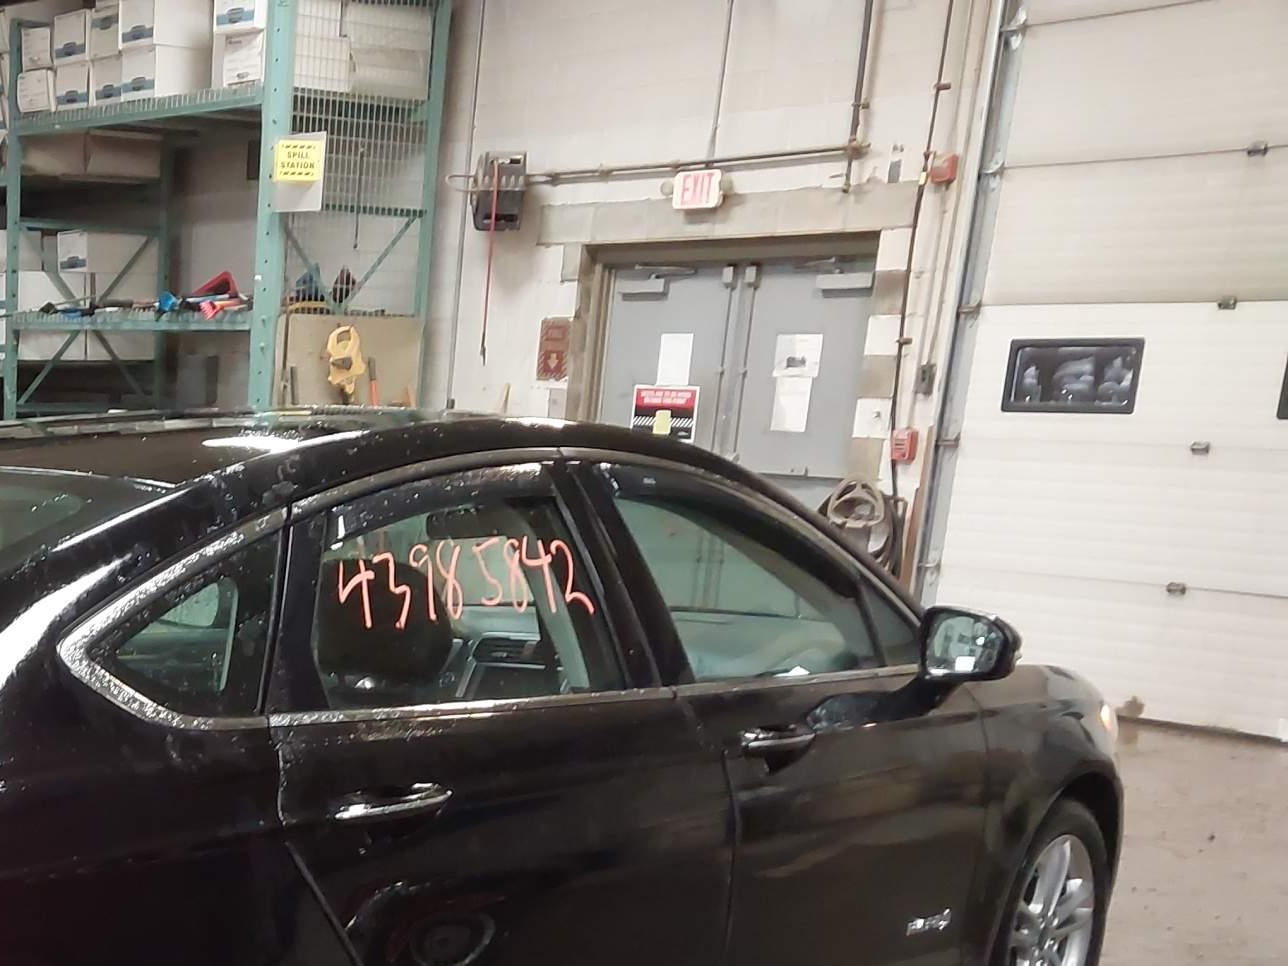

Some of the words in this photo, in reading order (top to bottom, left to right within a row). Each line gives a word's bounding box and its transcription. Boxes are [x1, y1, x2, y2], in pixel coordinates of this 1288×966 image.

[280, 161, 315, 169] STATION
[287, 151, 309, 159] SPILL
[681, 172, 714, 205] EXIT
[337, 535, 596, 630] 43985842
